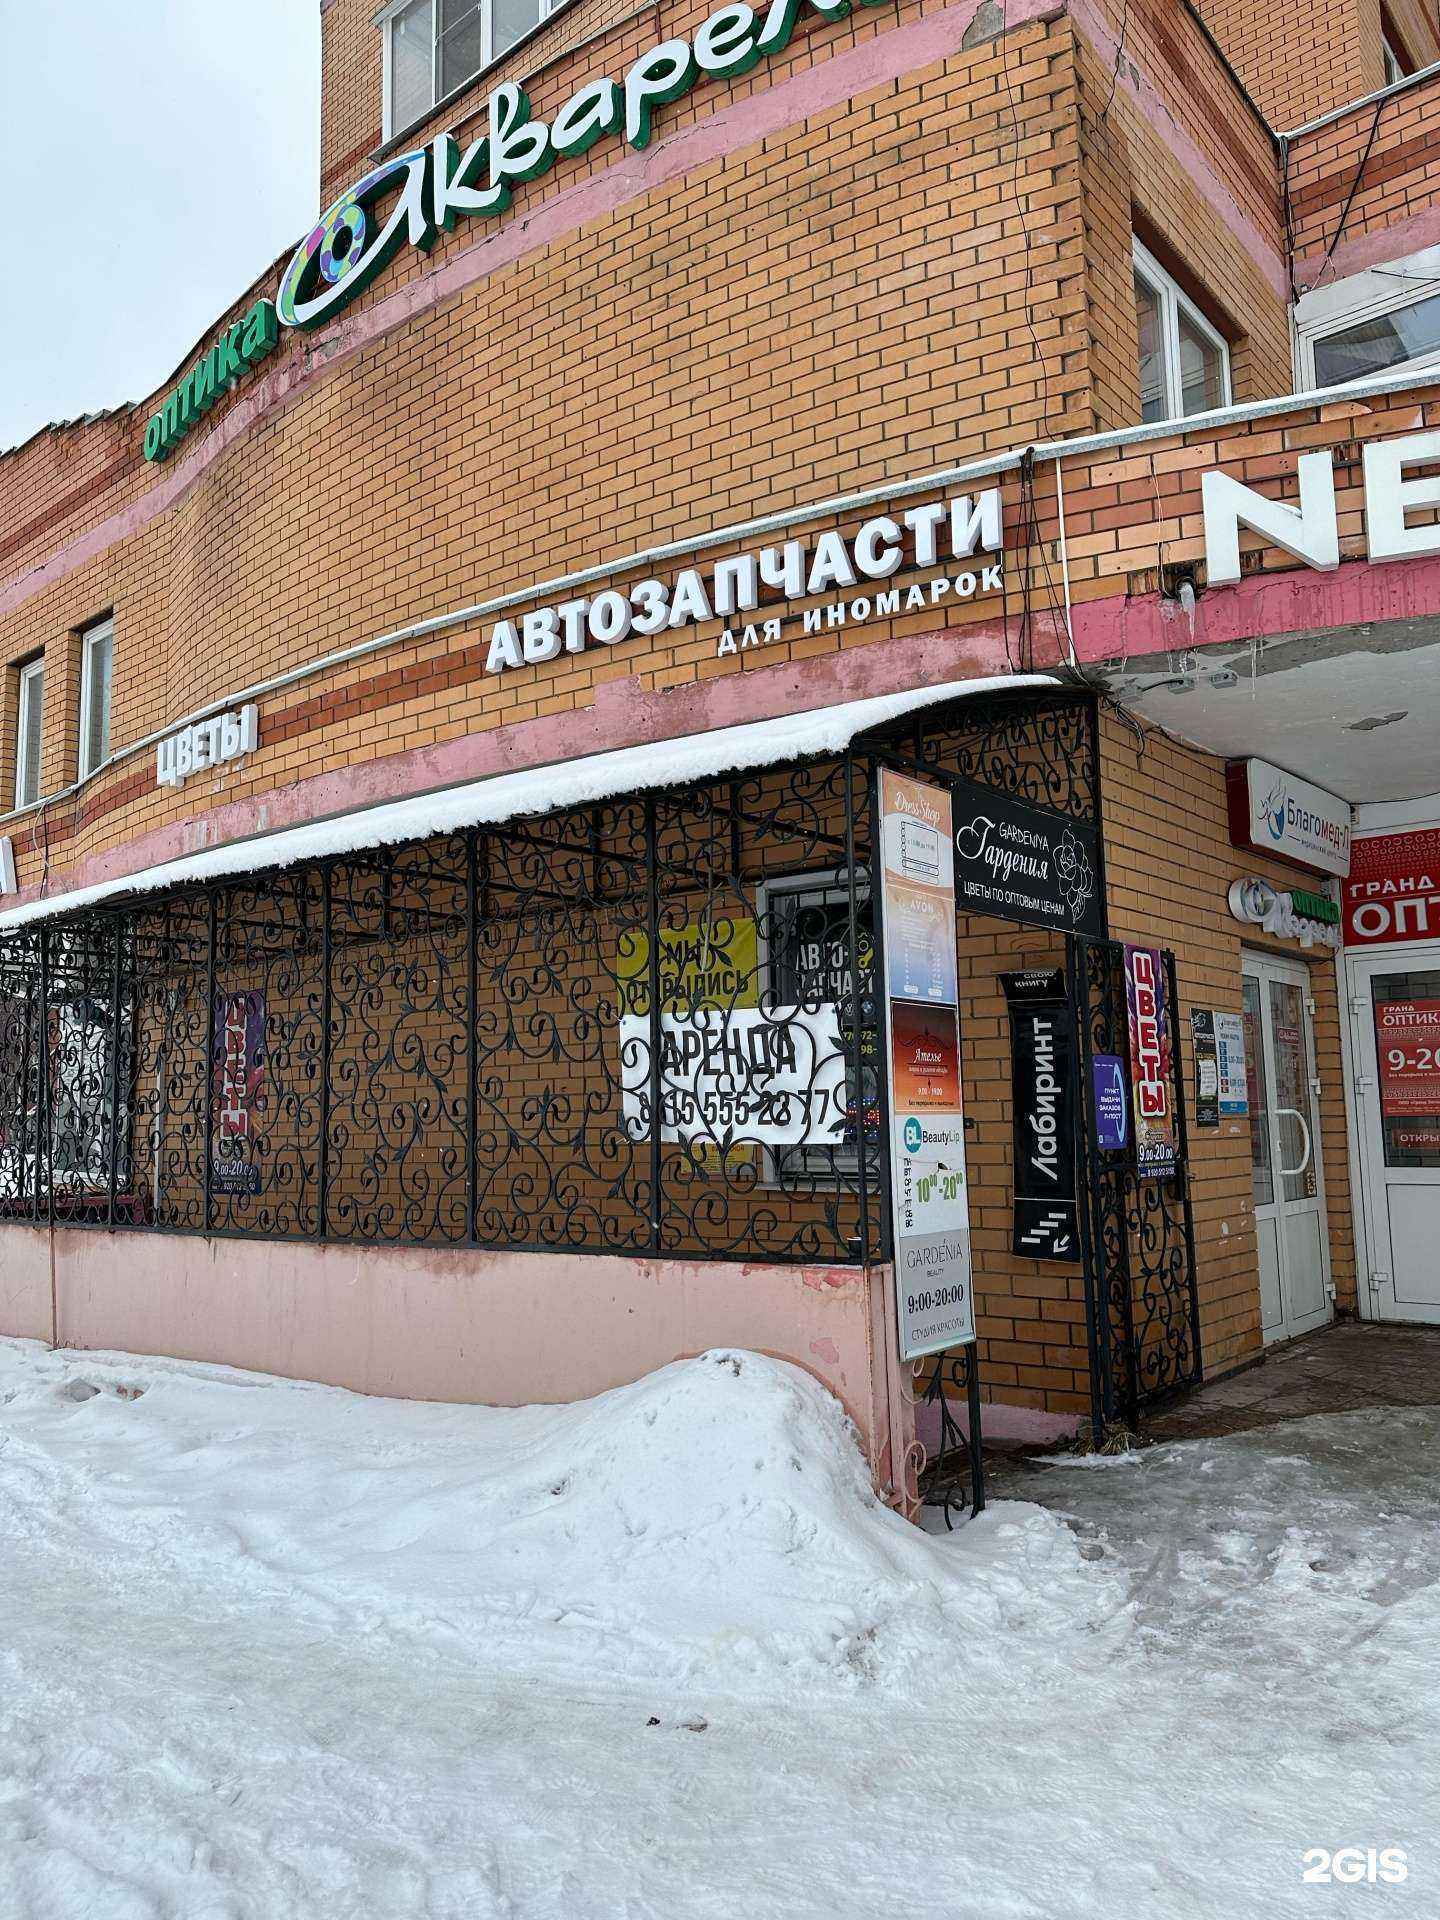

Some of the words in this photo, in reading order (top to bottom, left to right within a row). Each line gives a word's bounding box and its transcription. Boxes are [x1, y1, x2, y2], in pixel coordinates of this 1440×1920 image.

[143, 298, 278, 463] оптика
[485, 487, 1003, 673] АВТОЗАПЧАСТИ
[717, 622, 782, 657] ДЛЯ
[803, 565, 1003, 632] ИНОМАРОК
[156, 704, 258, 788] ЦВЕТЫ
[957, 816, 1049, 881] Гардения
[964, 881, 992, 898] ЦВЕТЫ
[993, 889, 1004, 902] ПО
[1005, 891, 1040, 910] ОПТОВЫМ
[1041, 900, 1065, 916] ЦЕНАМ
[1134, 955, 1164, 1114] ЦВЕТЫ
[1383, 1012, 1440, 1026] ОПТИК
[663, 1026, 797, 1079] АРЕНДА
[914, 1048, 942, 1063] Ателье
[704, 1091, 750, 1126] 555
[797, 1089, 830, 1125] 77
[908, 1284, 964, 1314] 9:00-20:00
[912, 1325, 937, 1341] СТУДИЯ
